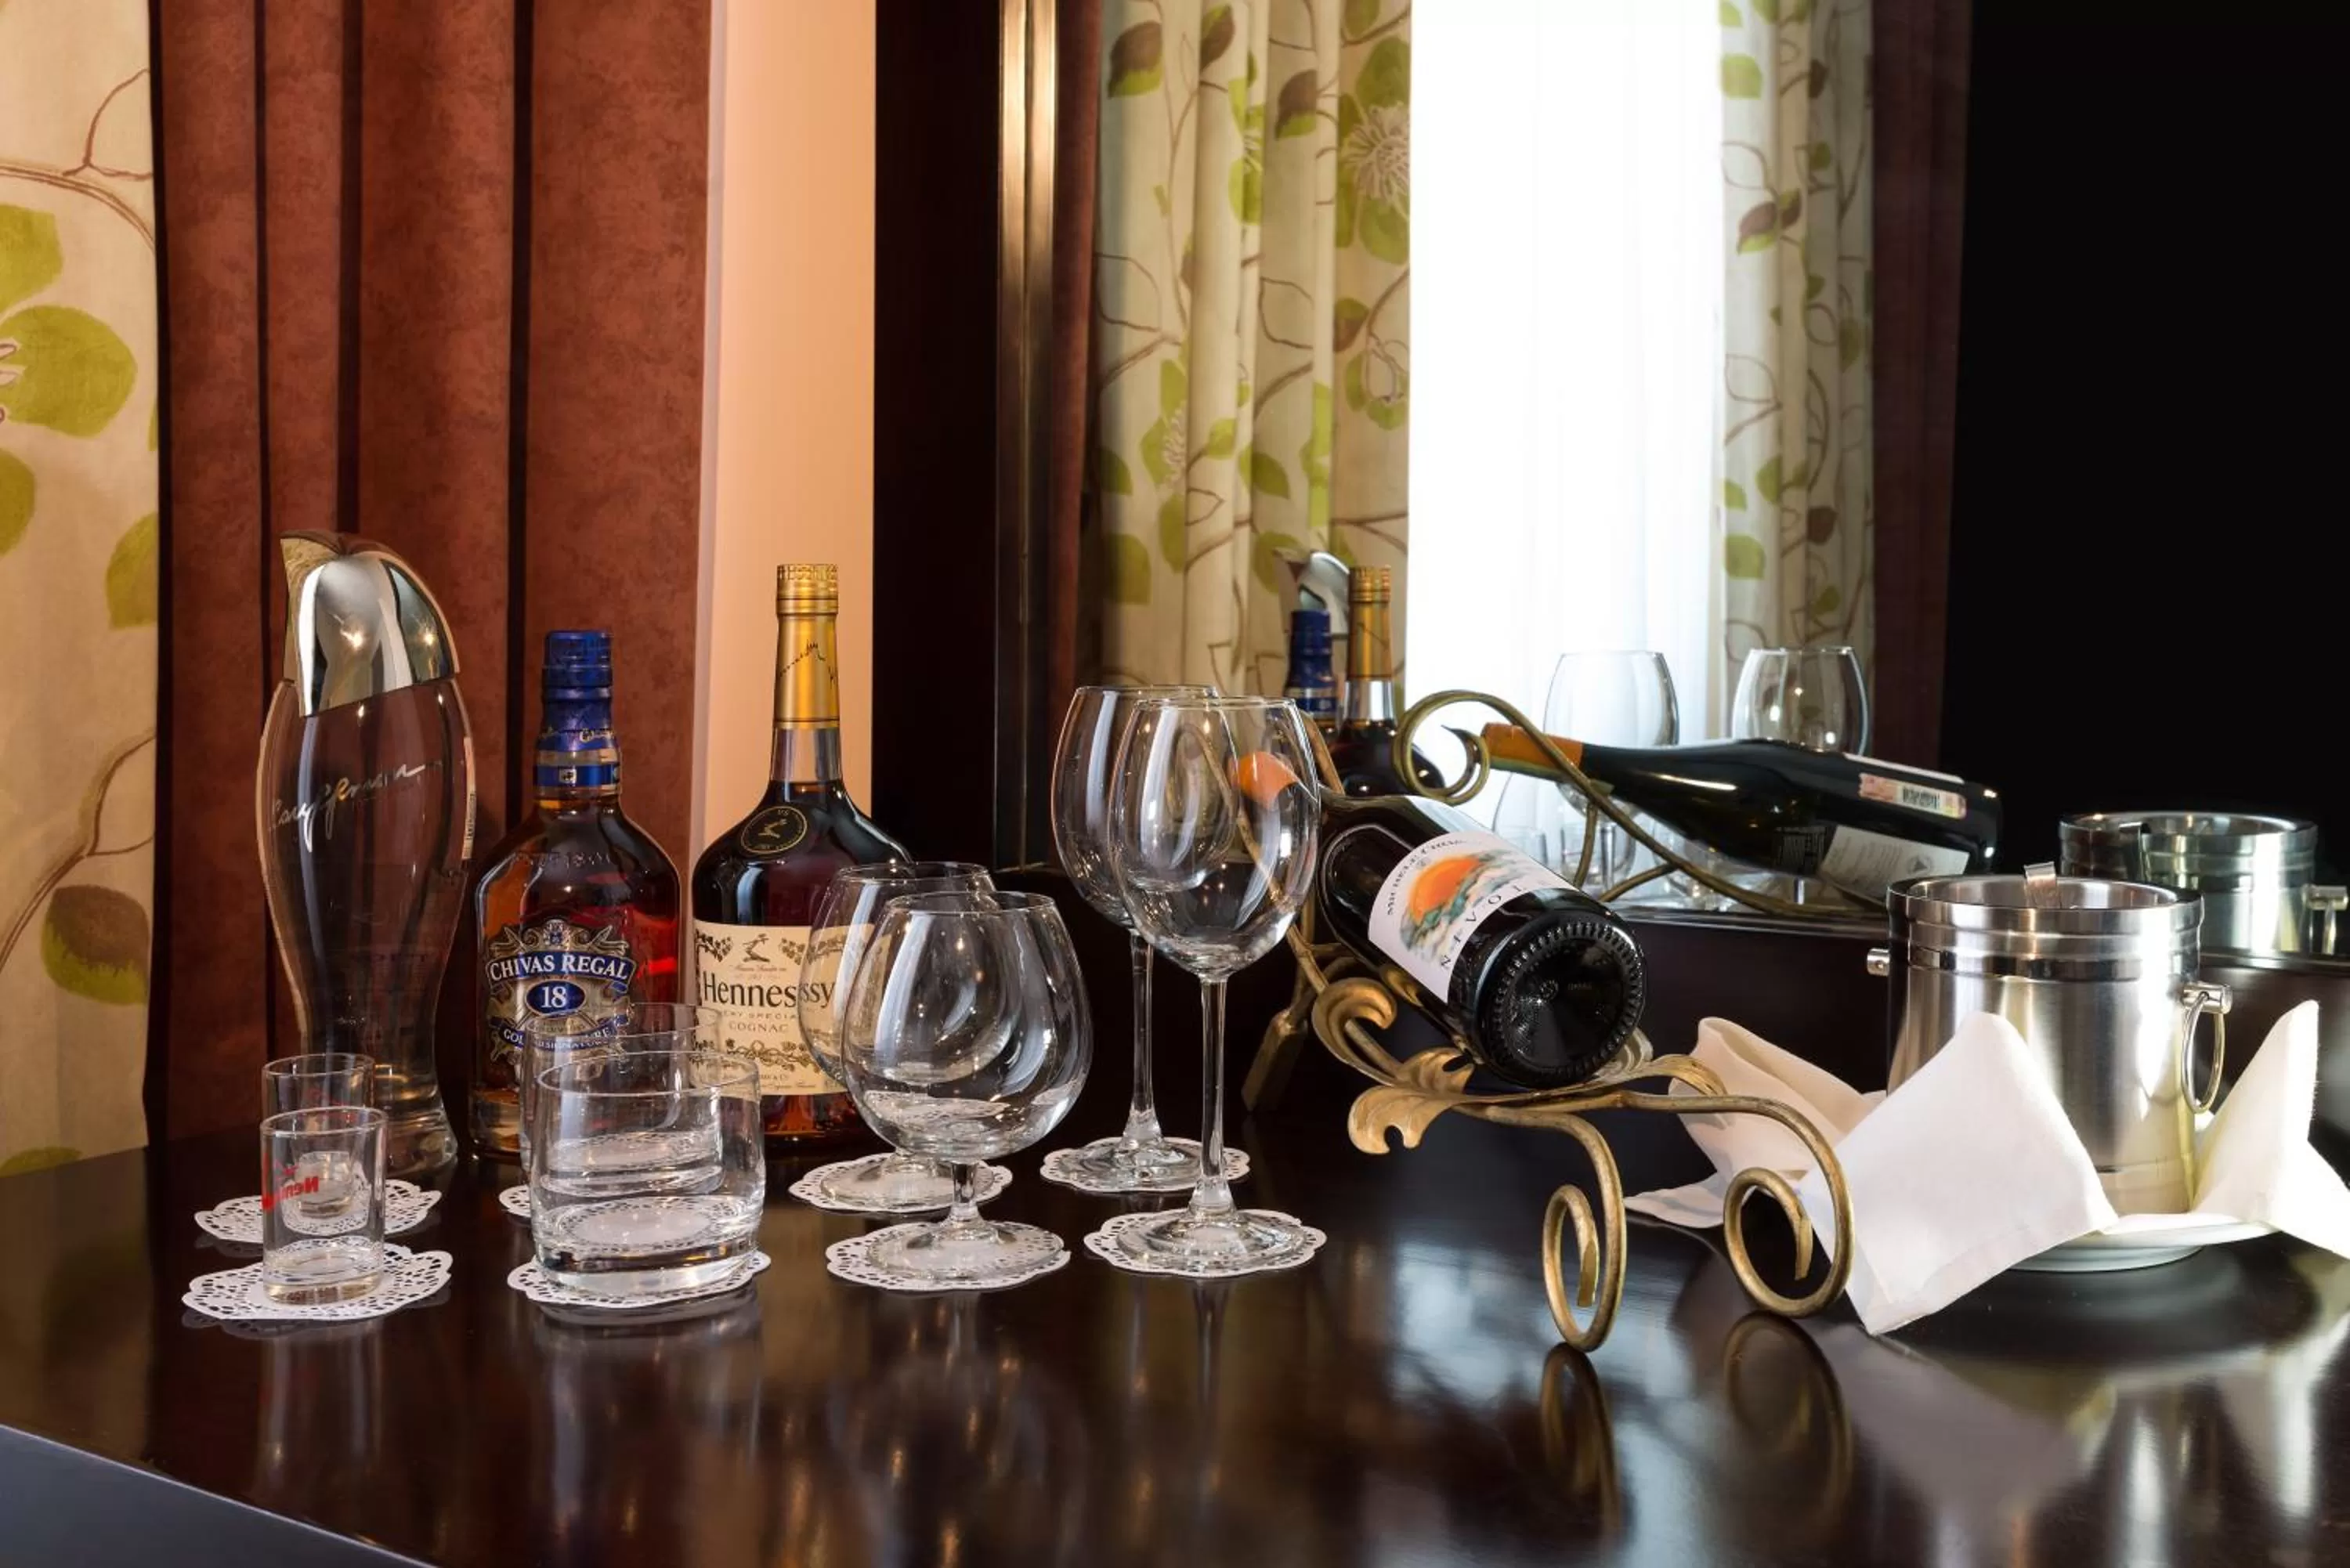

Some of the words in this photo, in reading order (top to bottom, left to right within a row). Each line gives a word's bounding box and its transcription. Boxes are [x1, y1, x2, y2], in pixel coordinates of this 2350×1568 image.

[490, 954, 555, 981] CHIVAS
[561, 953, 628, 980] REGAL
[540, 986, 568, 1009] 18
[703, 970, 835, 1008] Hennessy
